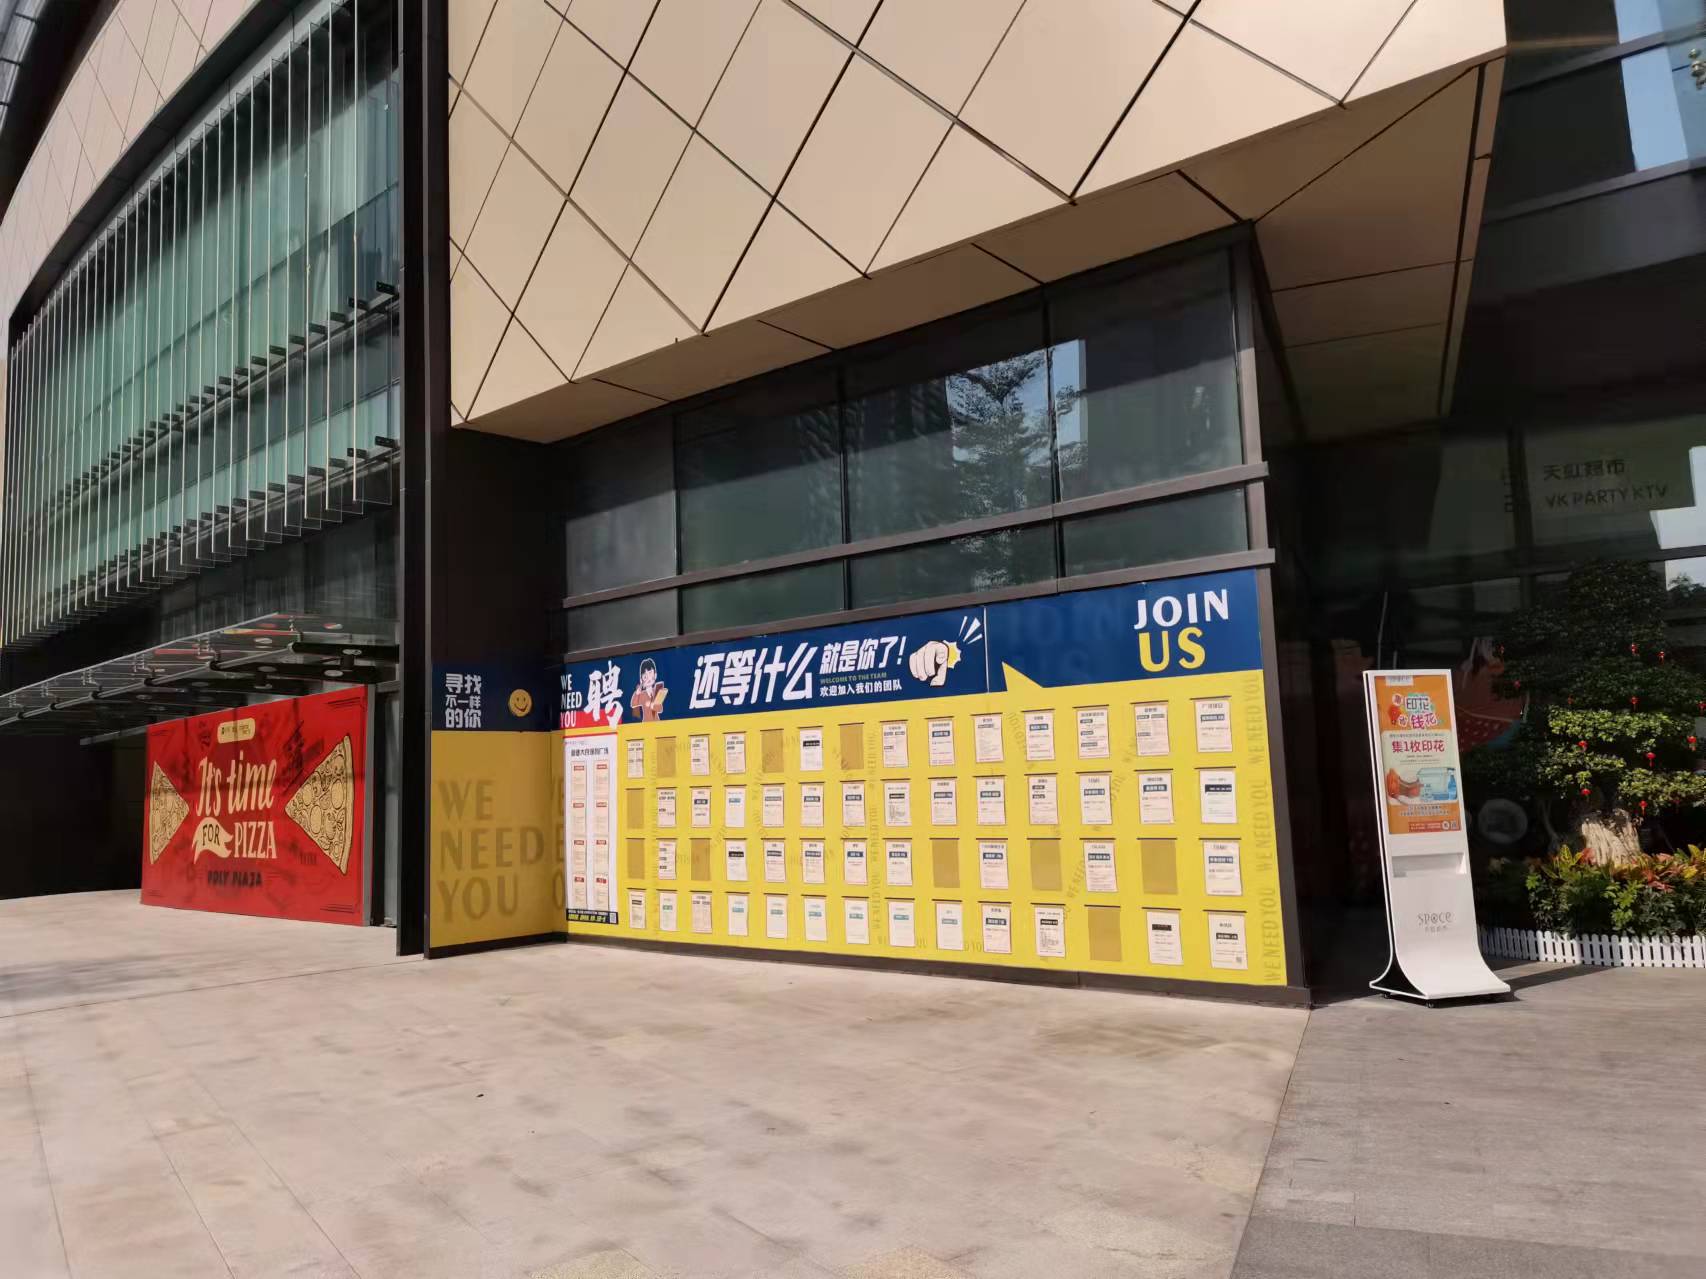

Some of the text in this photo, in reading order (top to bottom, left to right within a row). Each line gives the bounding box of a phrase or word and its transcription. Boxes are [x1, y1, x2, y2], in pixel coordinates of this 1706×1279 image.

[1545, 482, 1667, 508] VK PARTY KTV
[1134, 589, 1229, 630] JOIN
[819, 635, 906, 675] 就是你了!
[1138, 627, 1206, 672] US
[445, 673, 482, 695] 寻找
[560, 674, 572, 693] WE
[689, 642, 820, 710] 还等什么
[820, 679, 902, 697] 欢迎加入我们的团队
[848, 674, 857, 682] TO
[858, 673, 869, 681] THE
[870, 671, 887, 680] TEAM
[445, 694, 481, 709] 不一样
[561, 691, 583, 711] NEED
[584, 661, 623, 729] 聘
[445, 708, 482, 729] 的你
[560, 709, 577, 728] YOU
[1392, 740, 1444, 753] 集1枚印花
[196, 750, 277, 817] It's time
[437, 777, 494, 821] WE
[202, 820, 277, 859] FOR PIZZA
[440, 825, 545, 871] NEED
[437, 874, 518, 923] YOU
